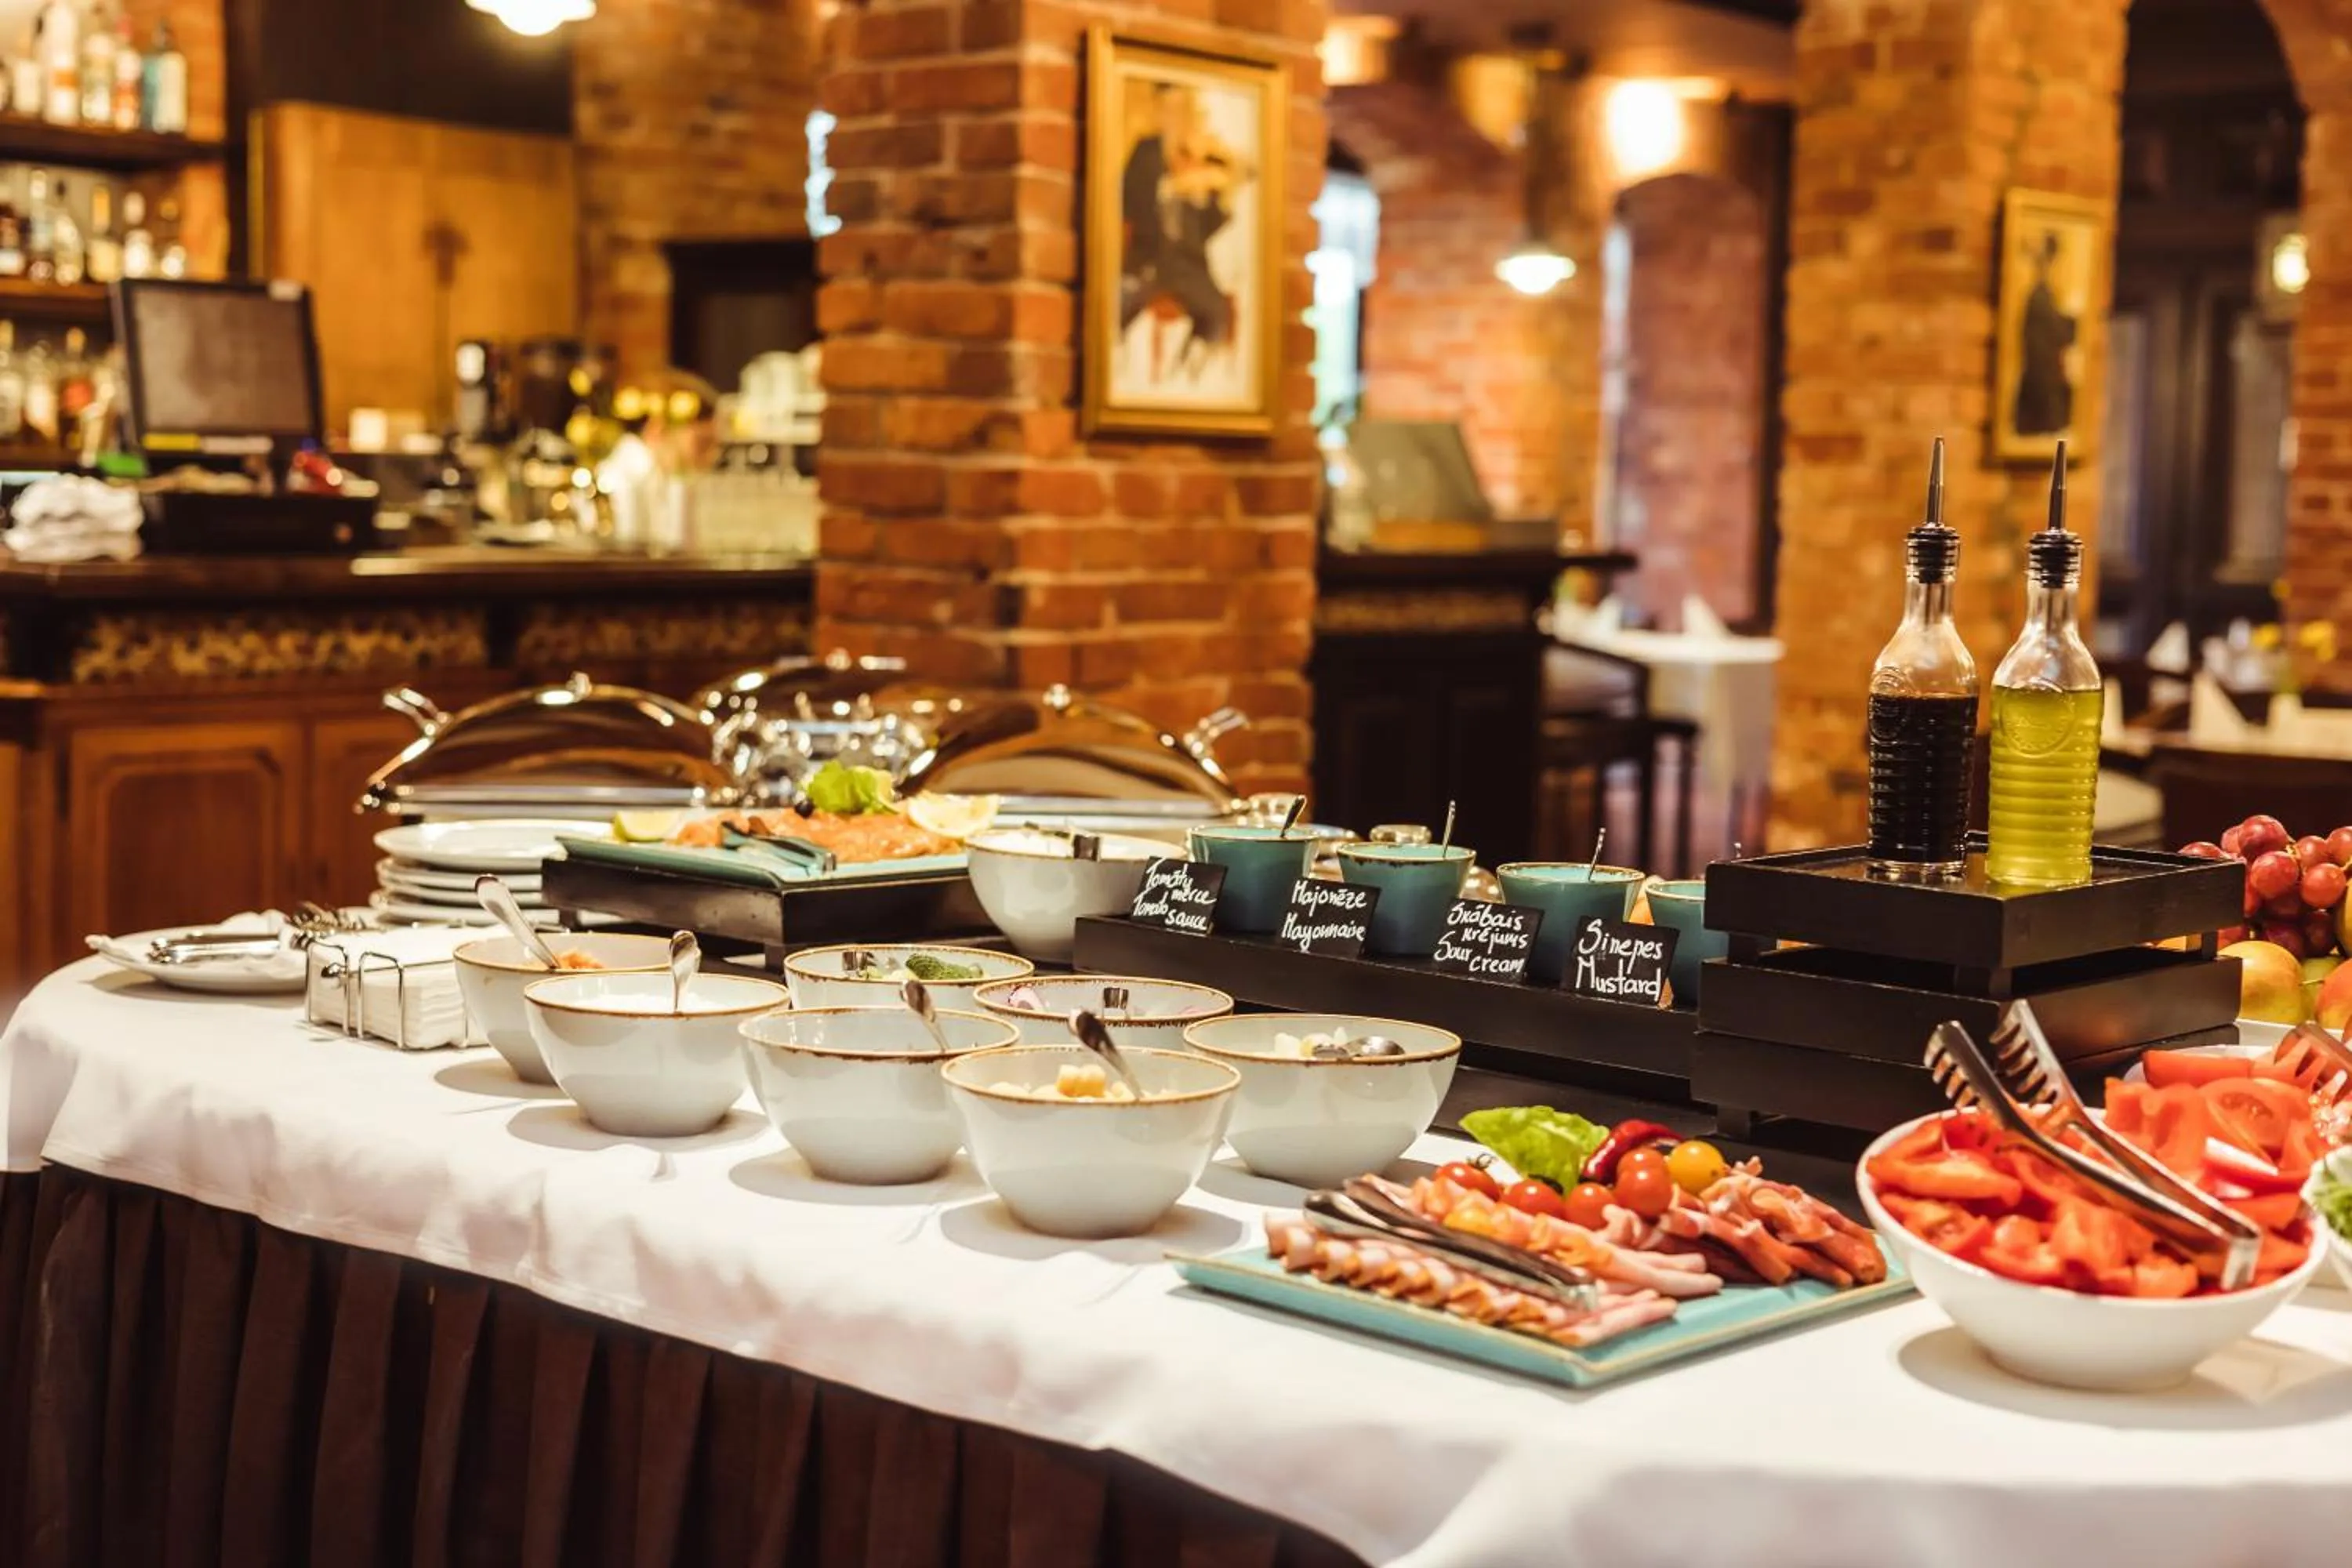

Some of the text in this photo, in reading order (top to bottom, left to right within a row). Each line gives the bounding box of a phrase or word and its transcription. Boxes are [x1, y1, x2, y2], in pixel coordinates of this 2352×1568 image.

[1433, 931, 1473, 961] Sour
[1578, 918, 1663, 975] Sinepes
[1575, 954, 1661, 1002] Mustard
